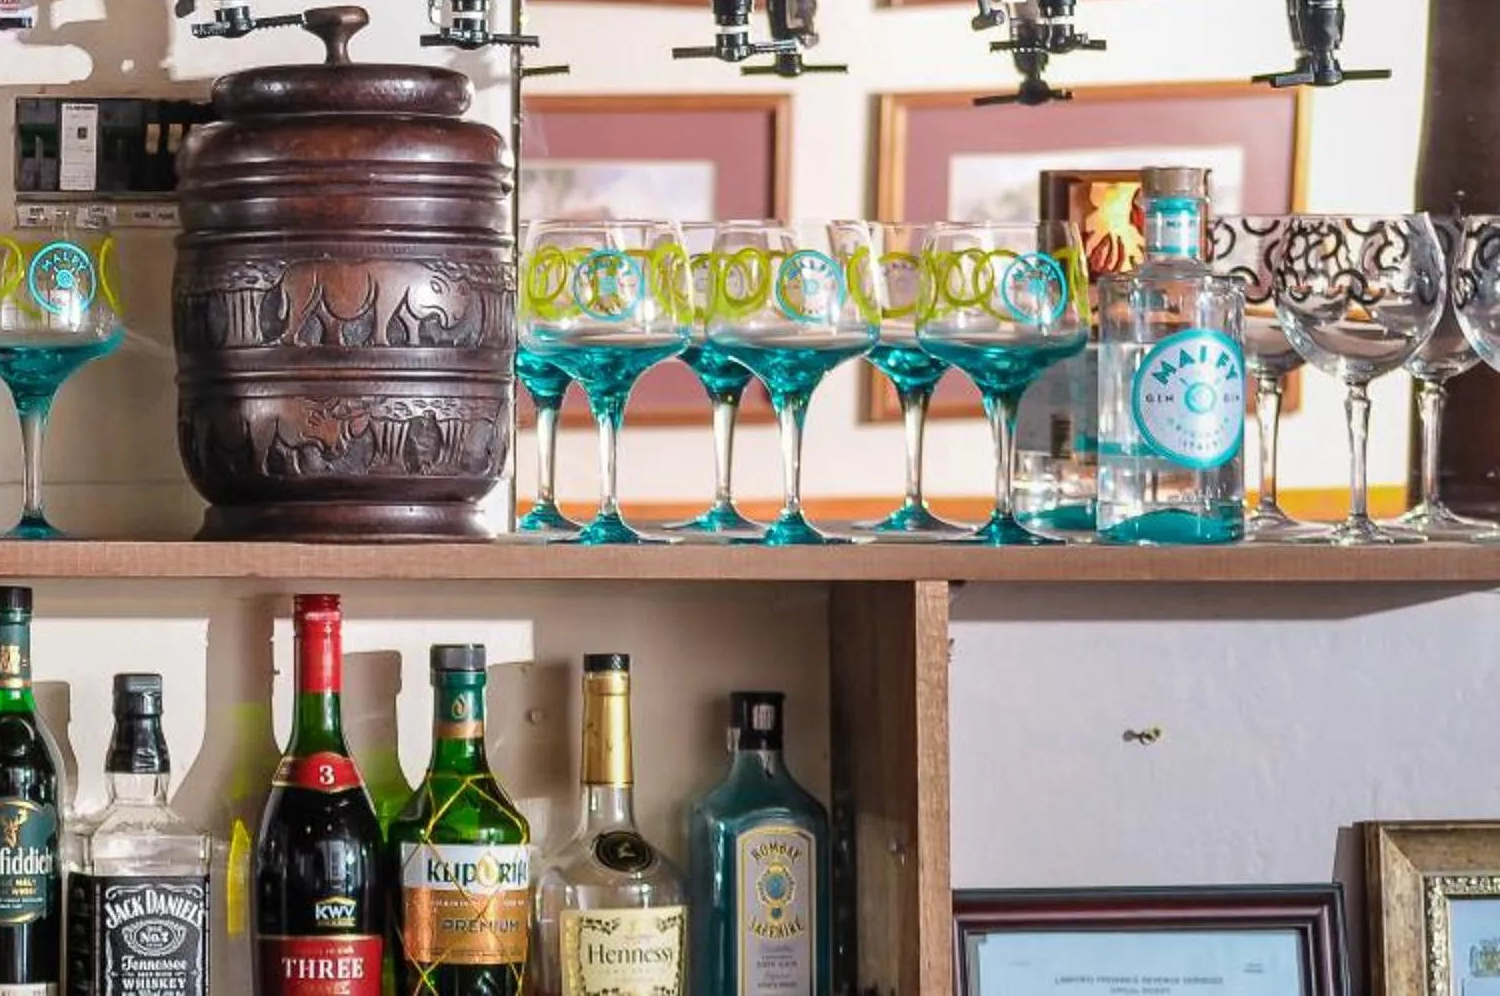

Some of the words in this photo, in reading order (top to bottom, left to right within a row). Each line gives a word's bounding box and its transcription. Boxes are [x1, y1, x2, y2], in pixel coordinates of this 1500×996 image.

[1145, 392, 1174, 403] GIN
[319, 764, 335, 785] 3
[751, 841, 803, 865] BOMBAY
[104, 895, 145, 930] JACK
[315, 904, 356, 921] KWV
[442, 919, 518, 933] PREMIUM
[121, 955, 188, 971] Tennessee
[281, 957, 364, 979] THREE
[121, 977, 187, 990] WHISKEY
